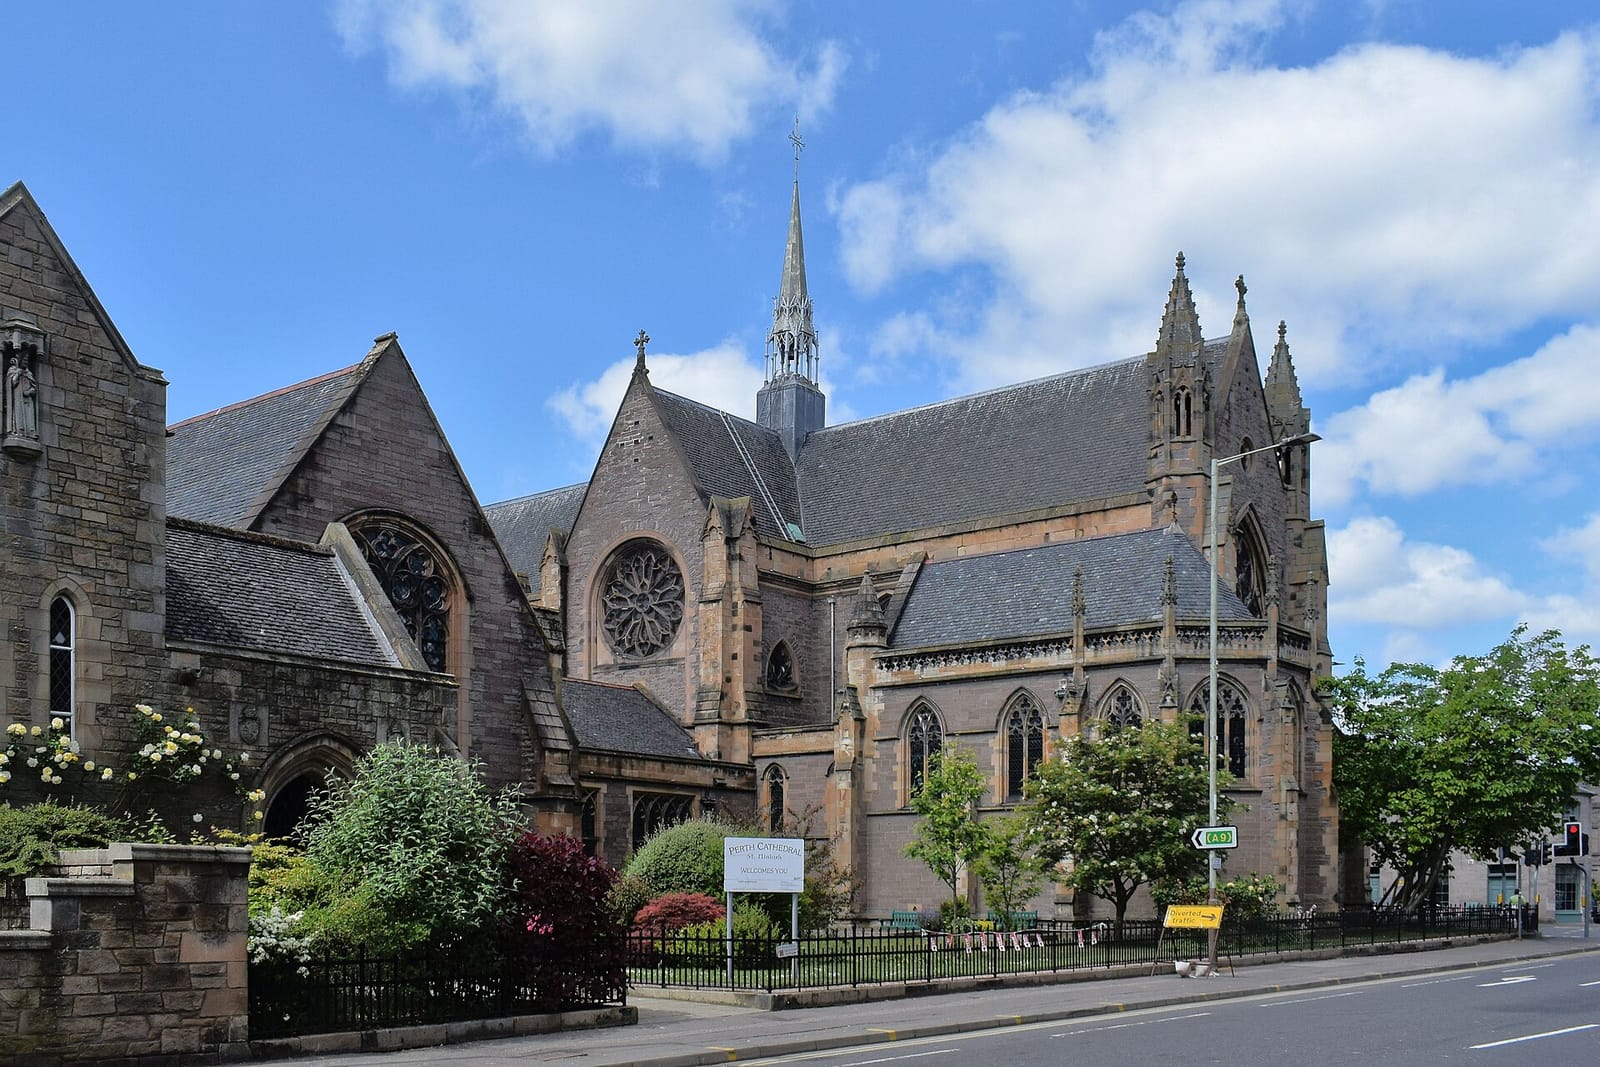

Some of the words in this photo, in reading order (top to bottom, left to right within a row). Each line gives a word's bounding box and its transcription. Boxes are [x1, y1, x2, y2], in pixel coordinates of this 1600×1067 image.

[729, 844, 755, 855] PERTH
[757, 842, 802, 856] CATHEDRAL
[740, 866, 774, 874] WELCOMES
